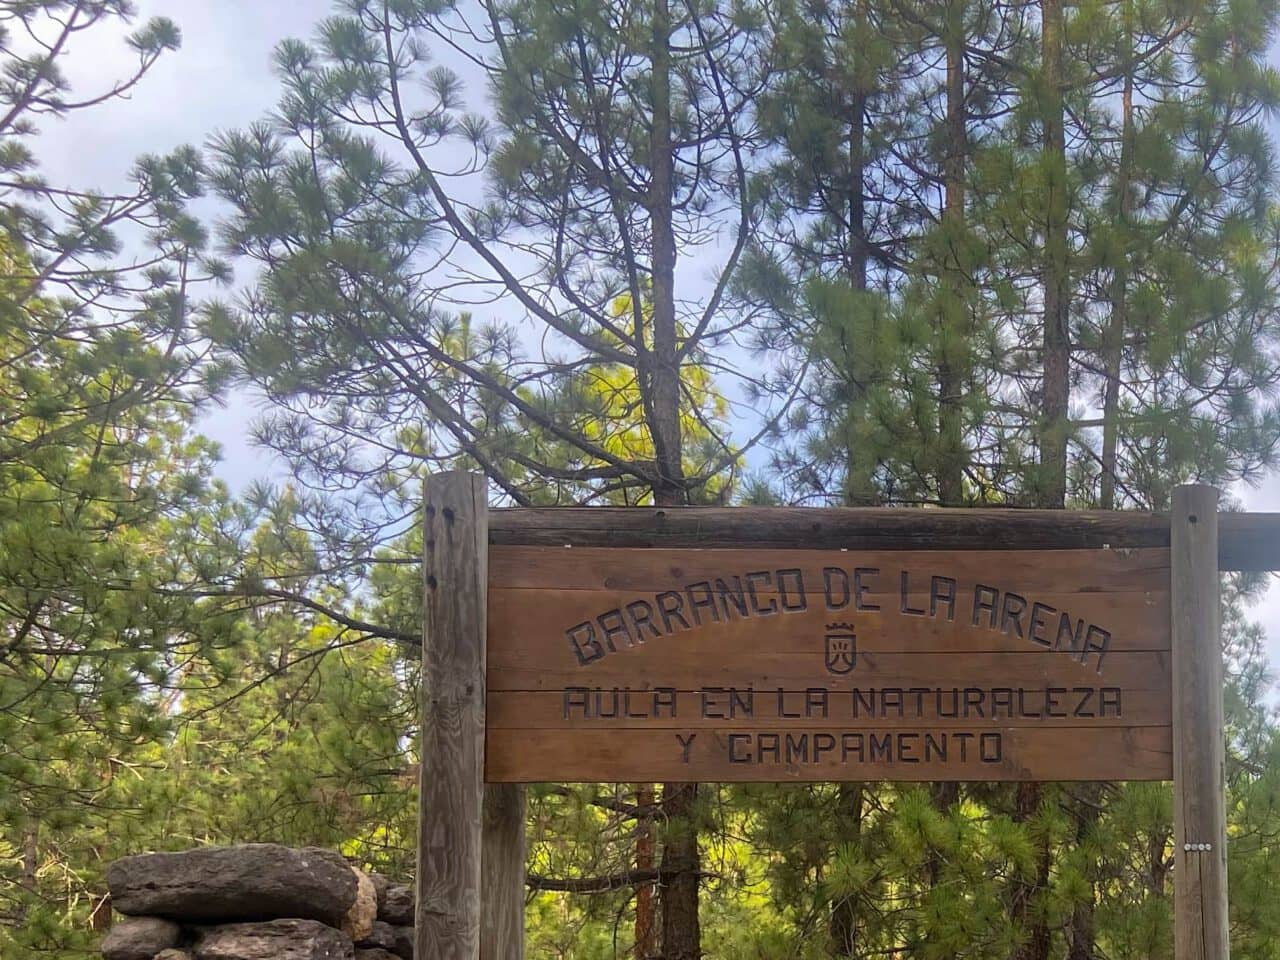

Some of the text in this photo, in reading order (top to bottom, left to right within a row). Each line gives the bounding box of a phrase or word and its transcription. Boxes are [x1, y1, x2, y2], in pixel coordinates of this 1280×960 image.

[563, 567, 1112, 673] BARRANCO DE LA ARENA
[563, 686, 1122, 721] AULA EN LA NATURALEZA
[676, 732, 1003, 764] Y CAMPAMENTO
